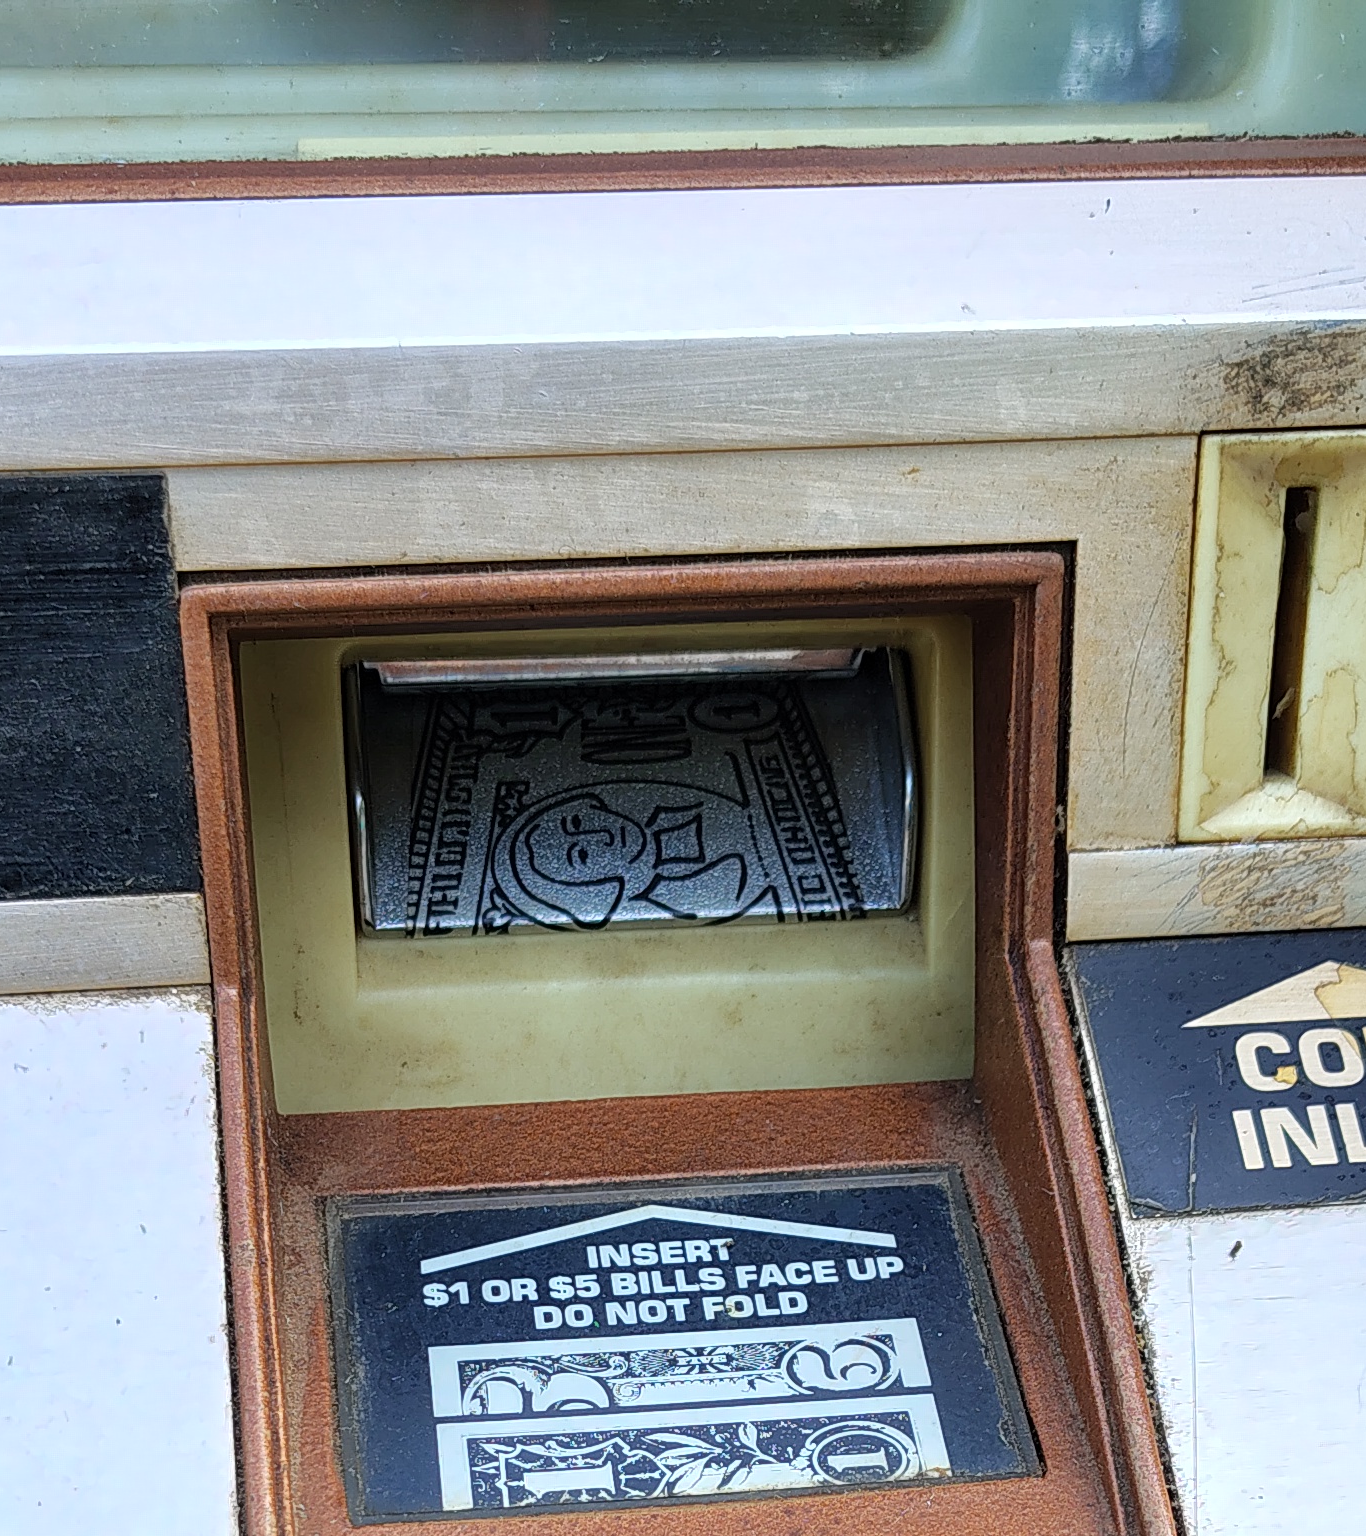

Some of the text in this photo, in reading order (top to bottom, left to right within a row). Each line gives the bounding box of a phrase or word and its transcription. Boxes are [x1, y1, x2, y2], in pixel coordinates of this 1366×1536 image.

[586, 1237, 734, 1269] INSERT
[422, 1255, 905, 1308] $1 OR $5 BILLS FACE UP
[533, 1289, 809, 1330] DO NOT FOLD
